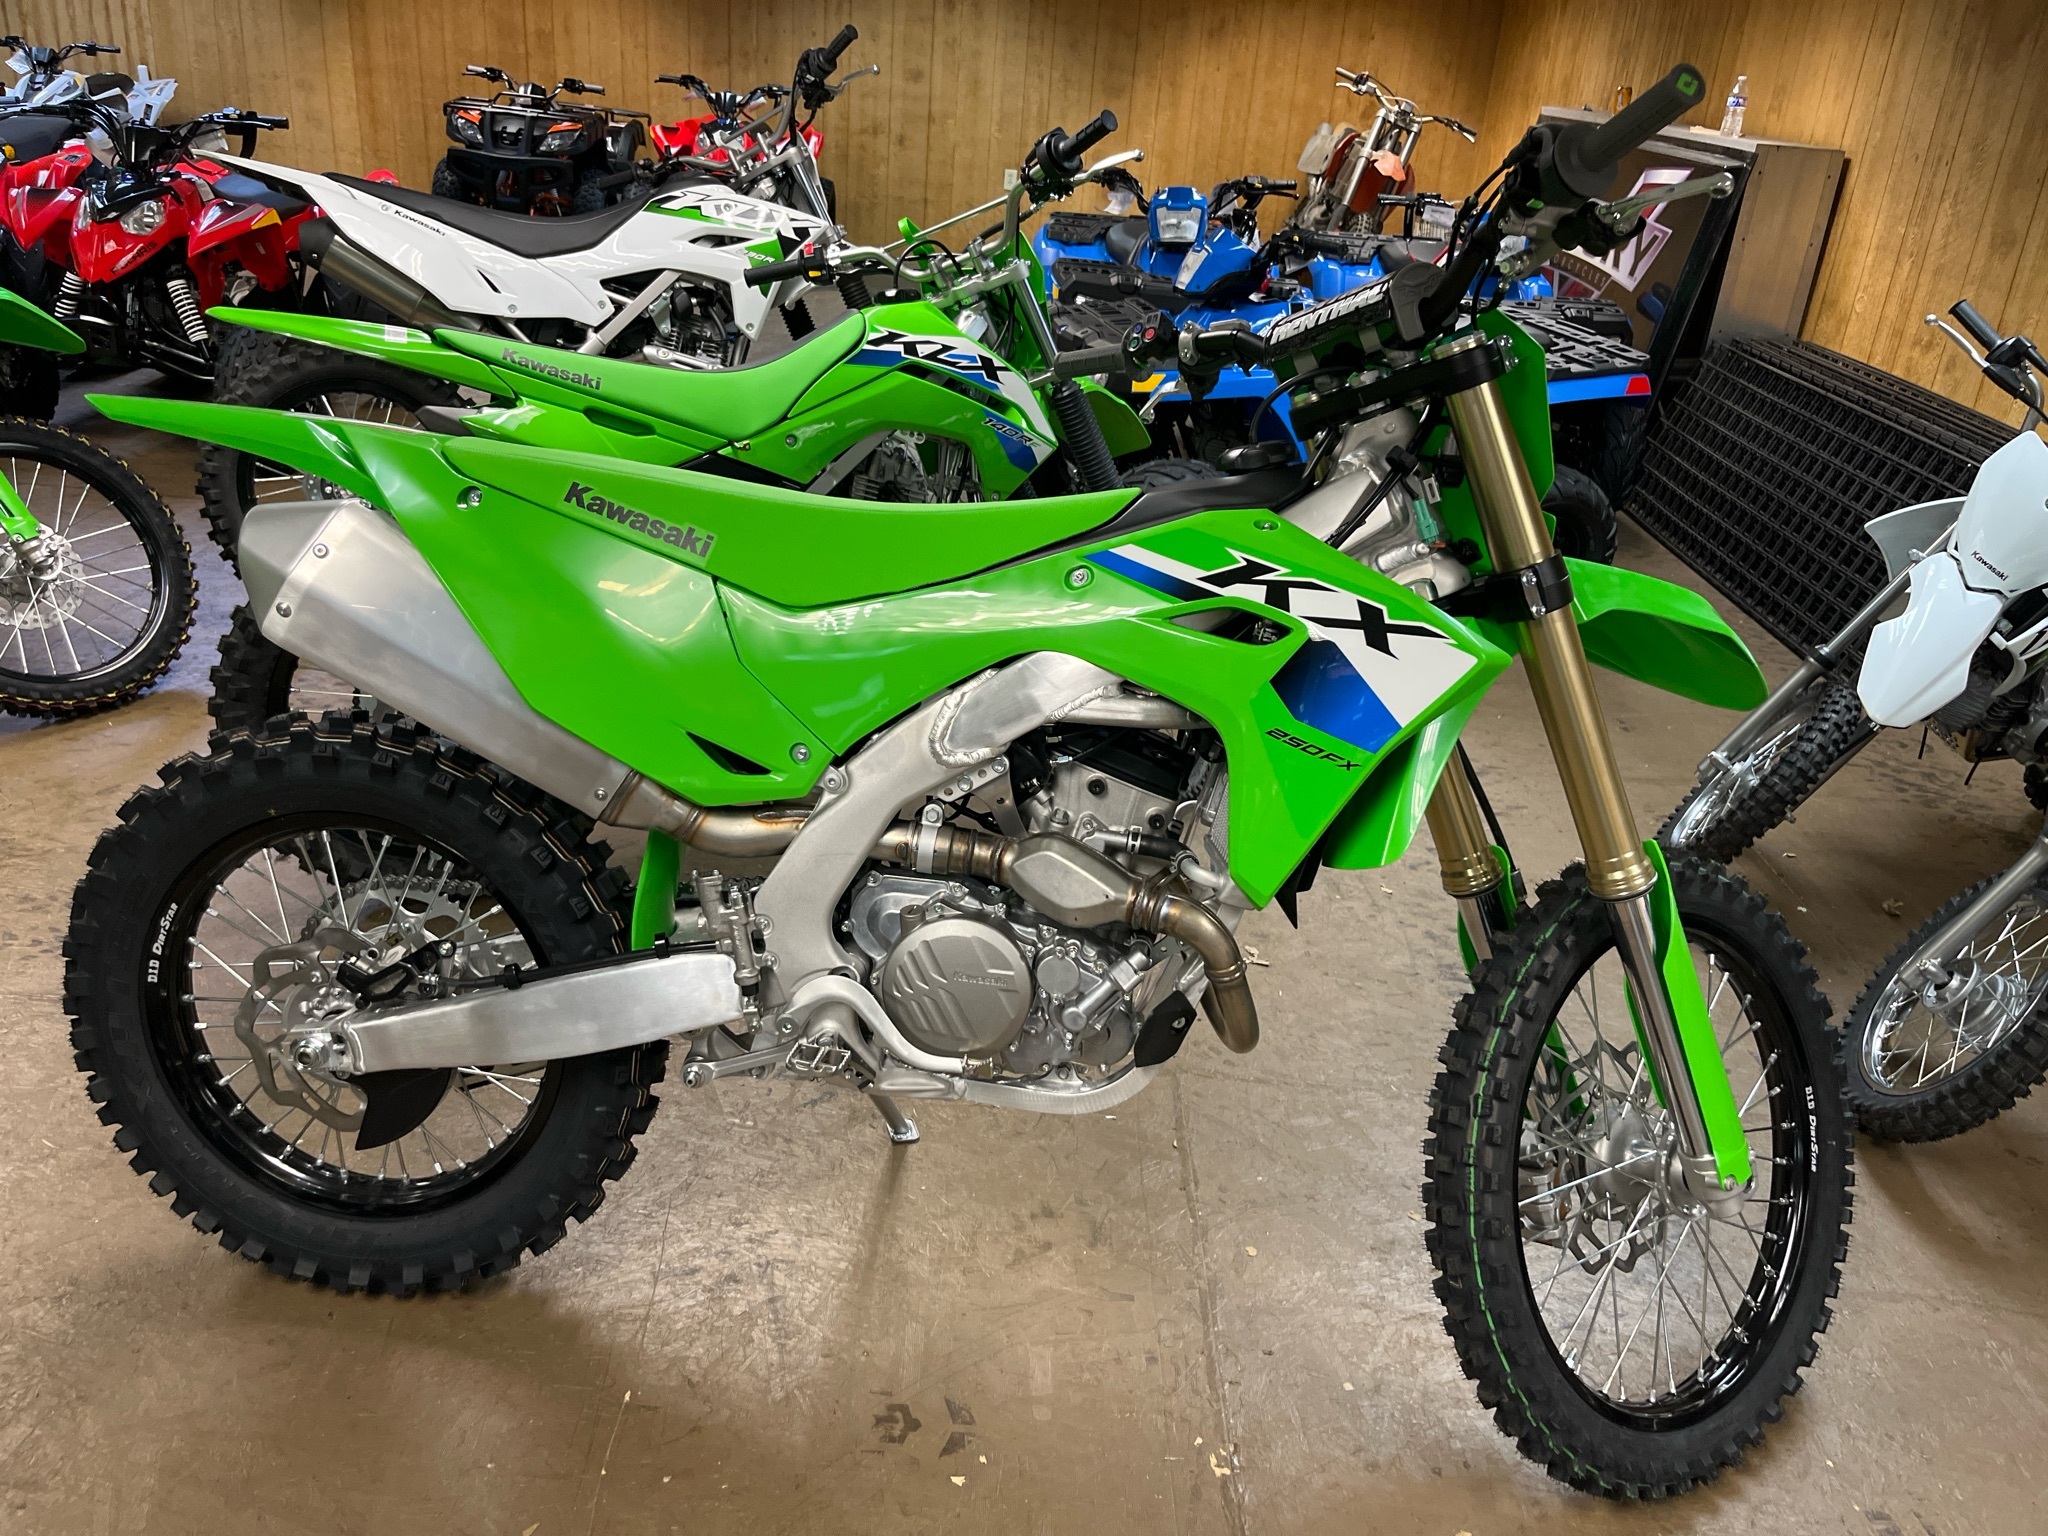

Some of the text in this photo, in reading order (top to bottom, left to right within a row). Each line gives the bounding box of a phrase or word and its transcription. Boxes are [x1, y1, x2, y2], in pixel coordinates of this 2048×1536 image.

[394, 209, 446, 236] Kawasaki
[1553, 253, 1608, 287] ORCYCLES
[1269, 283, 1385, 346] RENTHAL
[502, 347, 603, 391] Kawasaki
[866, 330, 1014, 386] KLX
[563, 481, 716, 558] Kawasaki
[1970, 550, 2009, 582] Kawasaki
[1196, 555, 1450, 660] KX
[1264, 727, 1363, 772] 250FX
[953, 971, 1007, 987] Kawasaki
